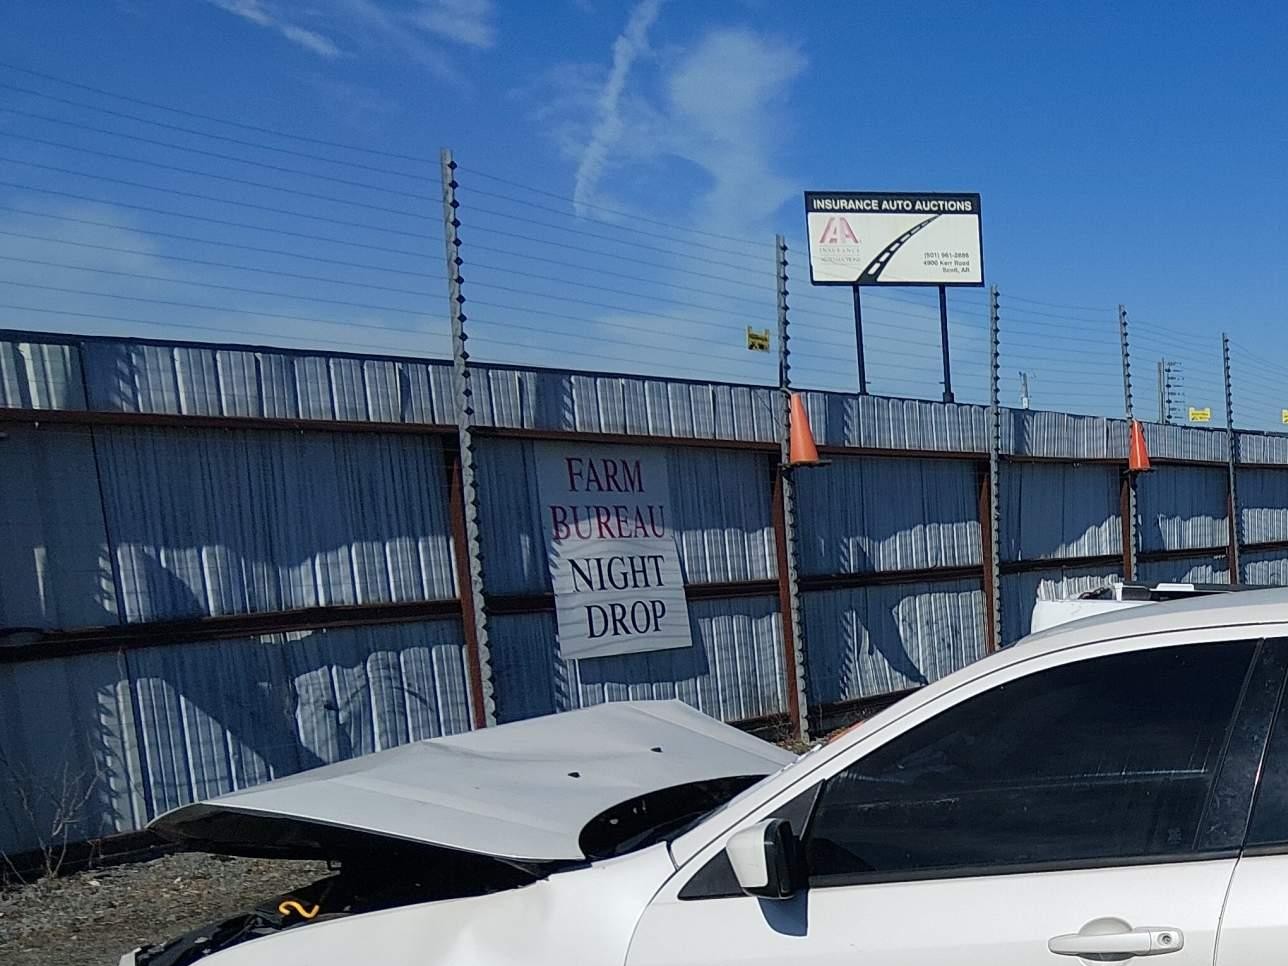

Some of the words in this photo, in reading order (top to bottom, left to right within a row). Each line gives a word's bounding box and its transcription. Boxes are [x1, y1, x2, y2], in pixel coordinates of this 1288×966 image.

[813, 199, 879, 211] INSURANCE
[881, 199, 912, 211] AUTO
[915, 200, 973, 212] AUCTIONS
[565, 457, 645, 494] FARM
[550, 505, 665, 540] BUREAU
[568, 555, 665, 592] NIGHT
[584, 600, 666, 639] DROP
